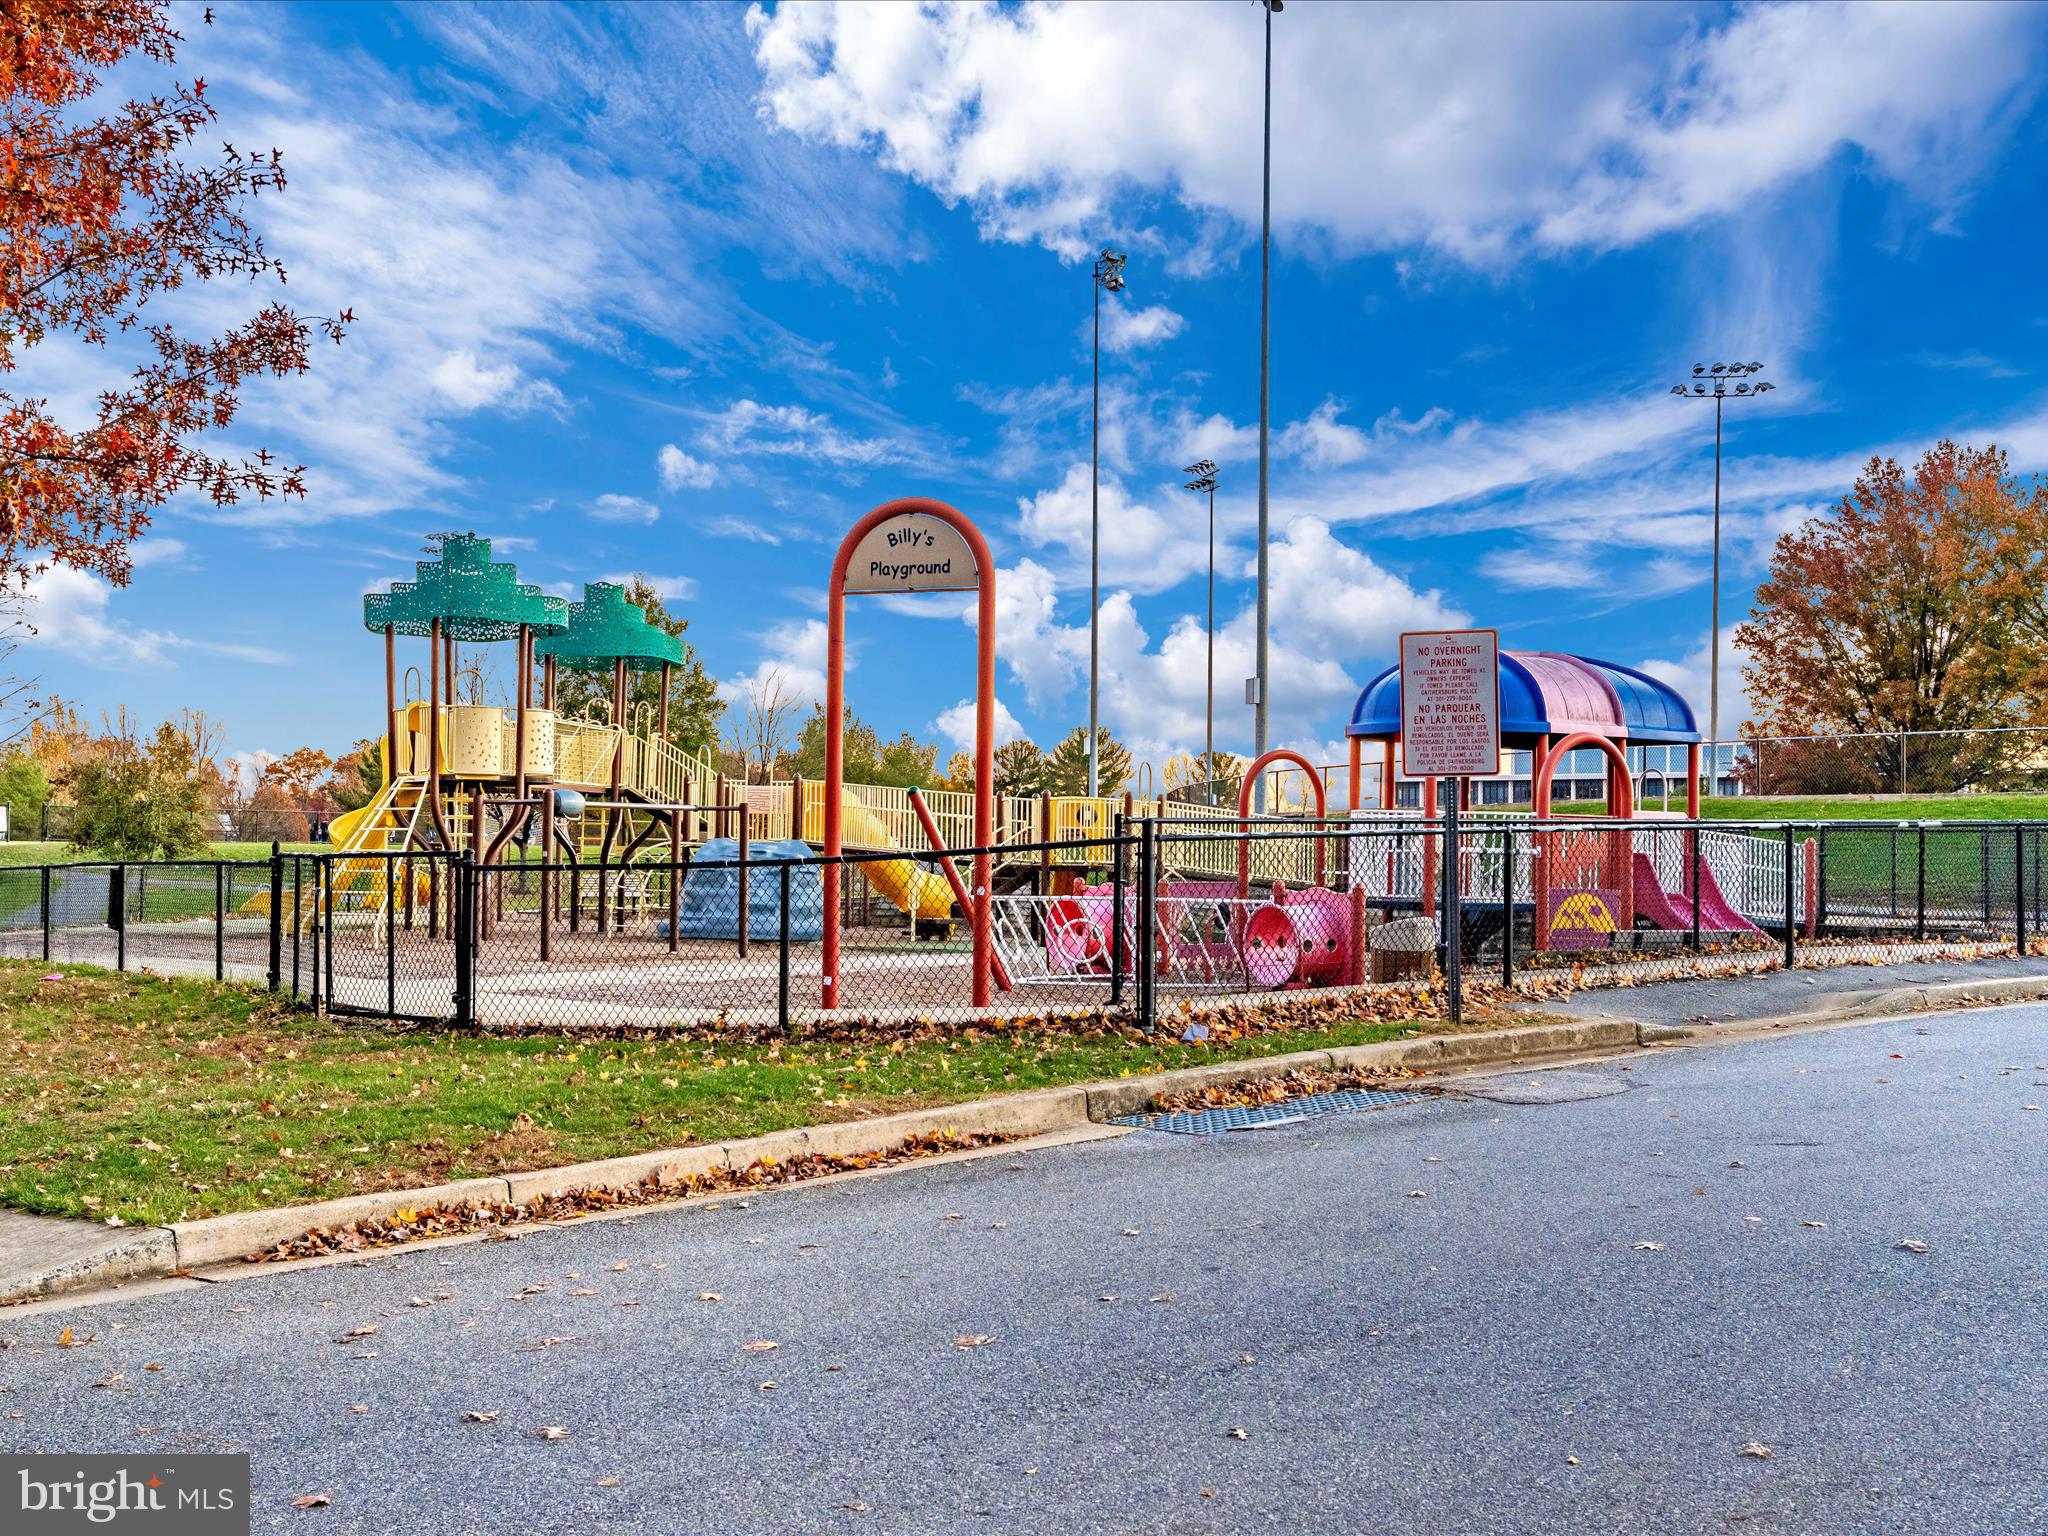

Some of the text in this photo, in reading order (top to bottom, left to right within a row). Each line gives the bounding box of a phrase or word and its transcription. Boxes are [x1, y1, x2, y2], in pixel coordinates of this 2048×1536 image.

[887, 528, 934, 548] Billy's
[870, 558, 951, 580] Playground
[1418, 646, 1480, 656] NO OVERNIGHT
[1430, 658, 1467, 667] PARKING
[1418, 704, 1480, 713] NO PARQUEAR
[1414, 714, 1486, 724] EN LAS NOCHES
